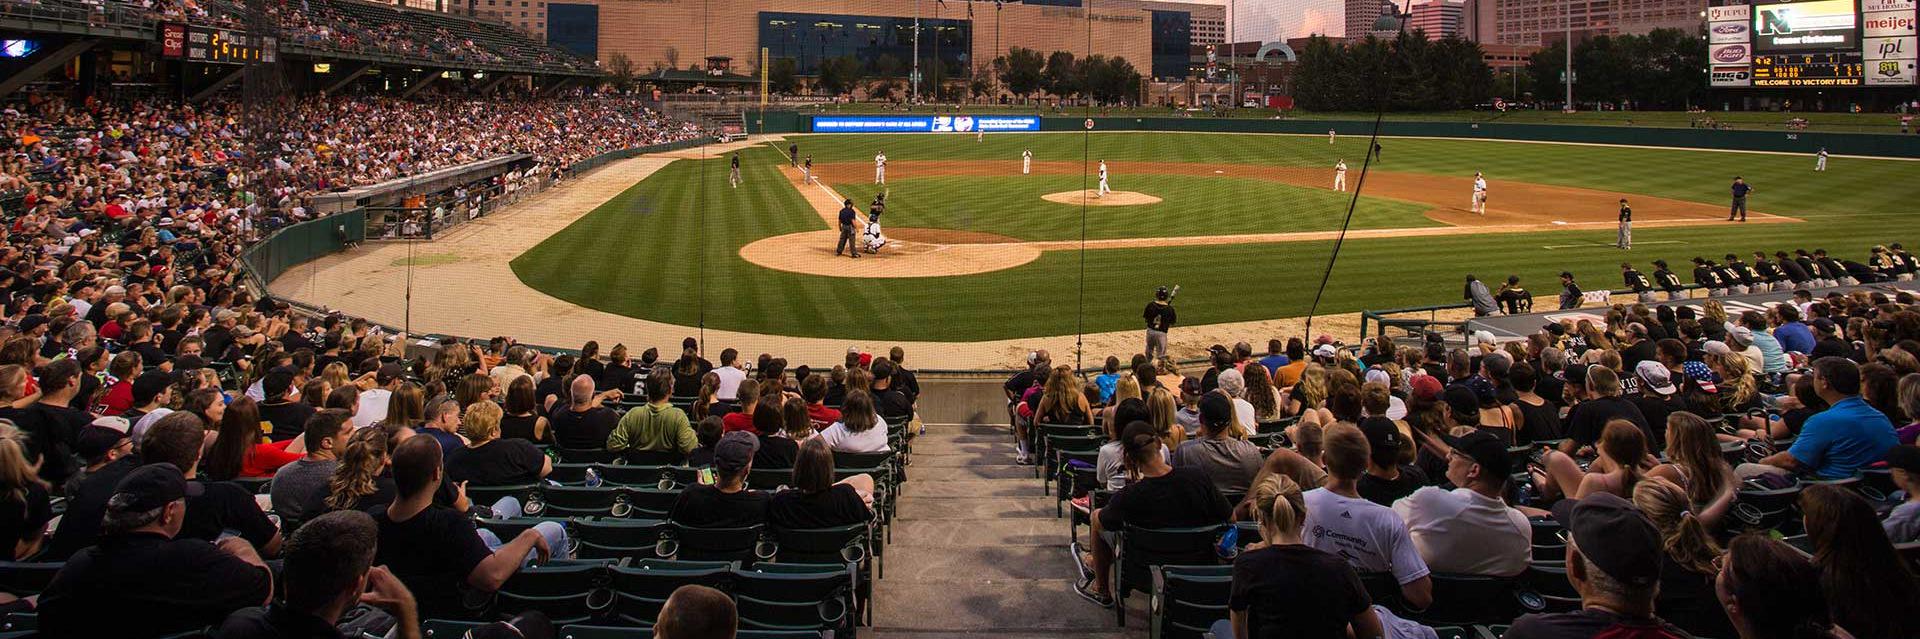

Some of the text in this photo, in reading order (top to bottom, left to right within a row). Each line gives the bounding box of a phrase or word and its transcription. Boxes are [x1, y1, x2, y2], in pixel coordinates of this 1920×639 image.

[1719, 24, 1741, 33] Ford
[1866, 16, 1914, 29] meijer
[164, 28, 184, 39] Great
[164, 39, 183, 50] Clips
[213, 33, 229, 54] 2 6
[1879, 39, 1904, 58] ipl
[1880, 62, 1899, 72] 811
[1638, 274, 1650, 288] 5
[633, 381, 645, 396] 6
[1326, 529, 1367, 547] Community
